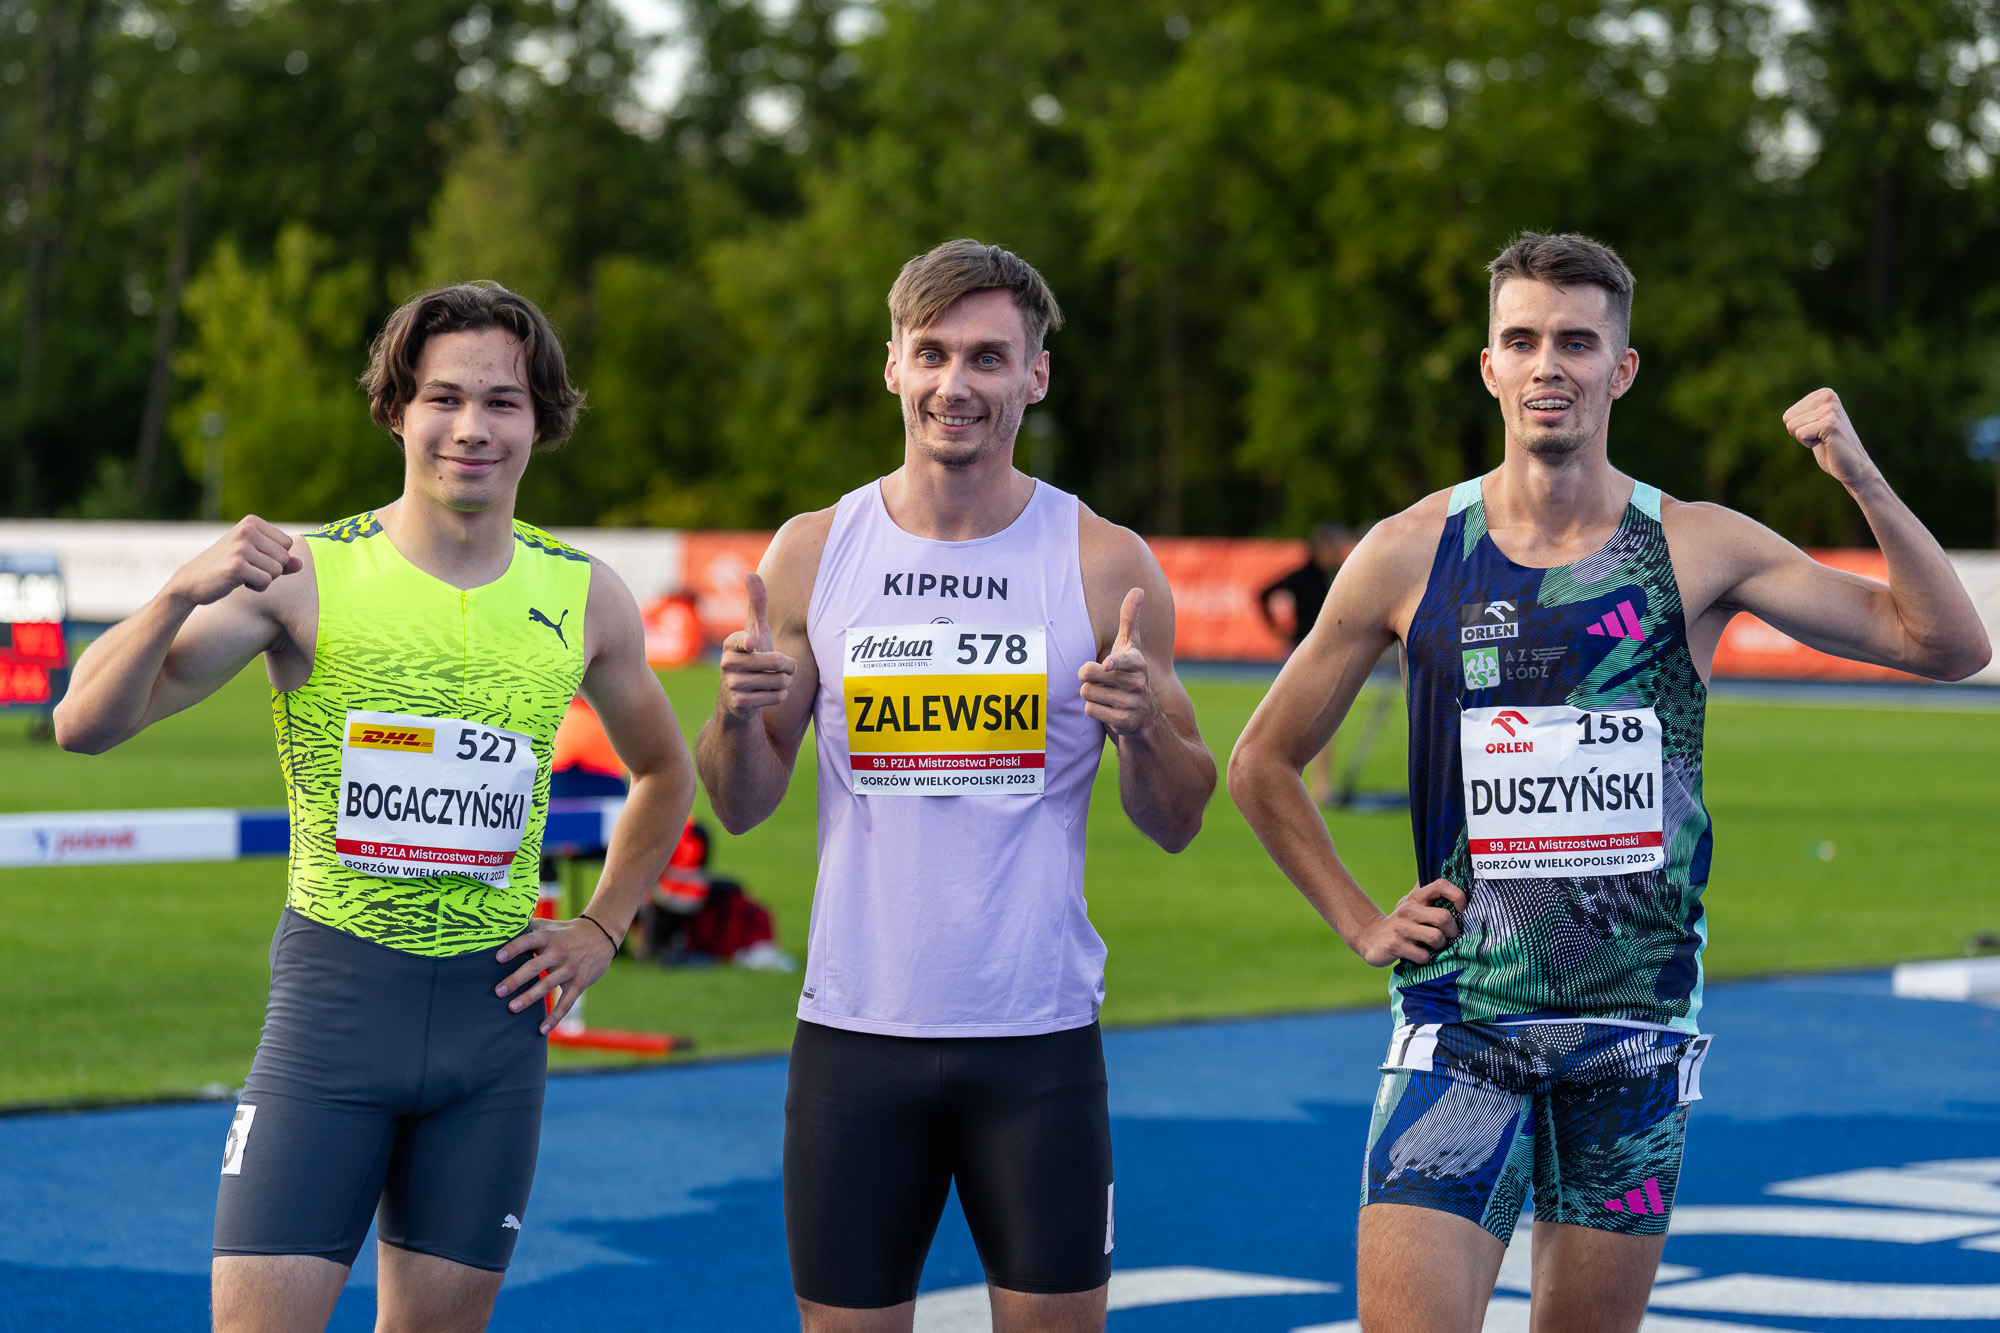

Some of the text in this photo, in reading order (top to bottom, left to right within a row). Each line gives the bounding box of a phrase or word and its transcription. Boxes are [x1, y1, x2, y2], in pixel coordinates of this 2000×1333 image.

[883, 573, 1008, 600] KIPRUN
[1464, 625, 1515, 640] ORLEN
[851, 635, 933, 662] Artisan
[956, 633, 1028, 665] 578
[854, 694, 1039, 732] ZALEWSKI
[361, 729, 422, 747] DHL
[1576, 713, 1644, 744] 158
[456, 728, 517, 763] 527
[1485, 741, 1533, 754] ORLEN
[872, 756, 1021, 768] 99. PZLA Mistrzostwa Polski
[860, 774, 1036, 786] GORZÓW WIELKOPOLSKI 2023
[1471, 766, 1654, 816] DUSZYŃSKI
[345, 781, 525, 830] BOGACZYŃSKI
[360, 844, 504, 864] 99. PZLA Mistrzostwa Polski
[1489, 835, 1639, 852] 99. PZLA Mistrzostwa Polski
[344, 860, 399, 875] GORZÓW
[489, 870, 505, 881] 2023
[1477, 853, 1656, 870] GORZÓW WIELKOPOLSKI 2023
[1684, 1039, 1709, 1095] 7
